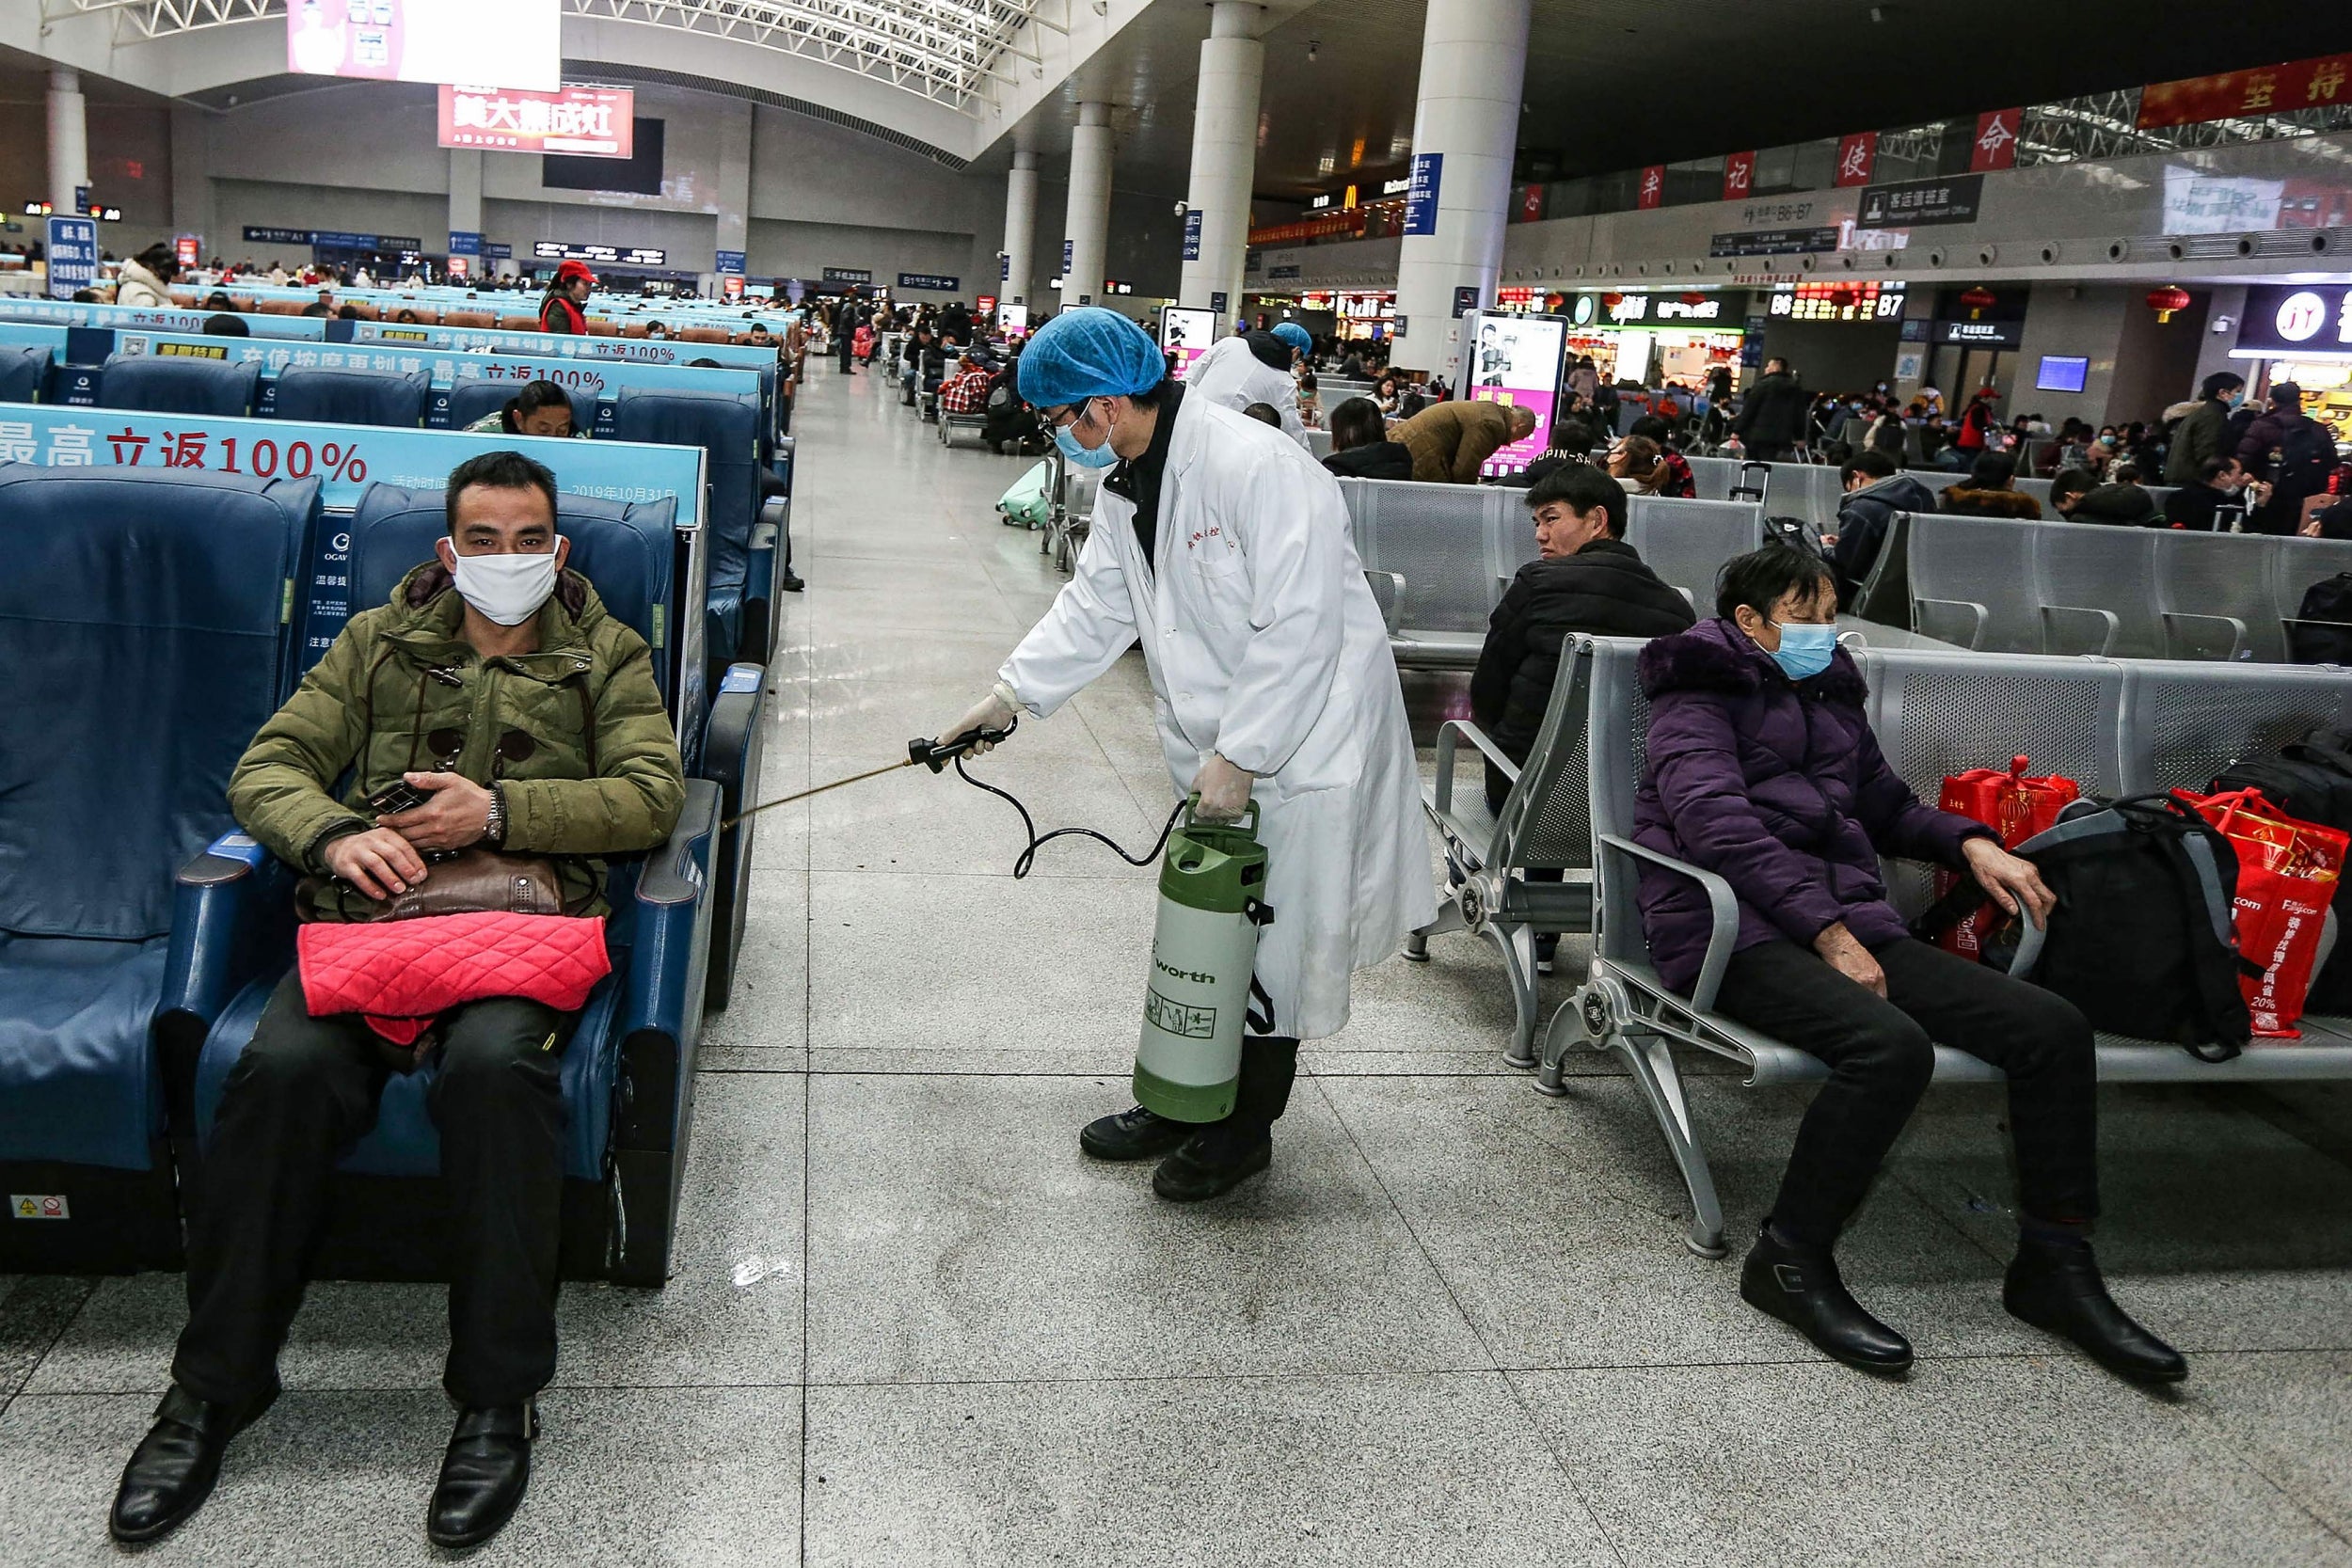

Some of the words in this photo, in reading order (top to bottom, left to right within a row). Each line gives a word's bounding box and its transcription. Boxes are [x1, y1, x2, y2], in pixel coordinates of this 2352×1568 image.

[1979, 115, 2011, 163] 命
[1842, 138, 1867, 178] 使
[1729, 161, 1747, 189] 记
[1877, 294, 1905, 317] B7
[2250, 996, 2276, 1009] 20%
